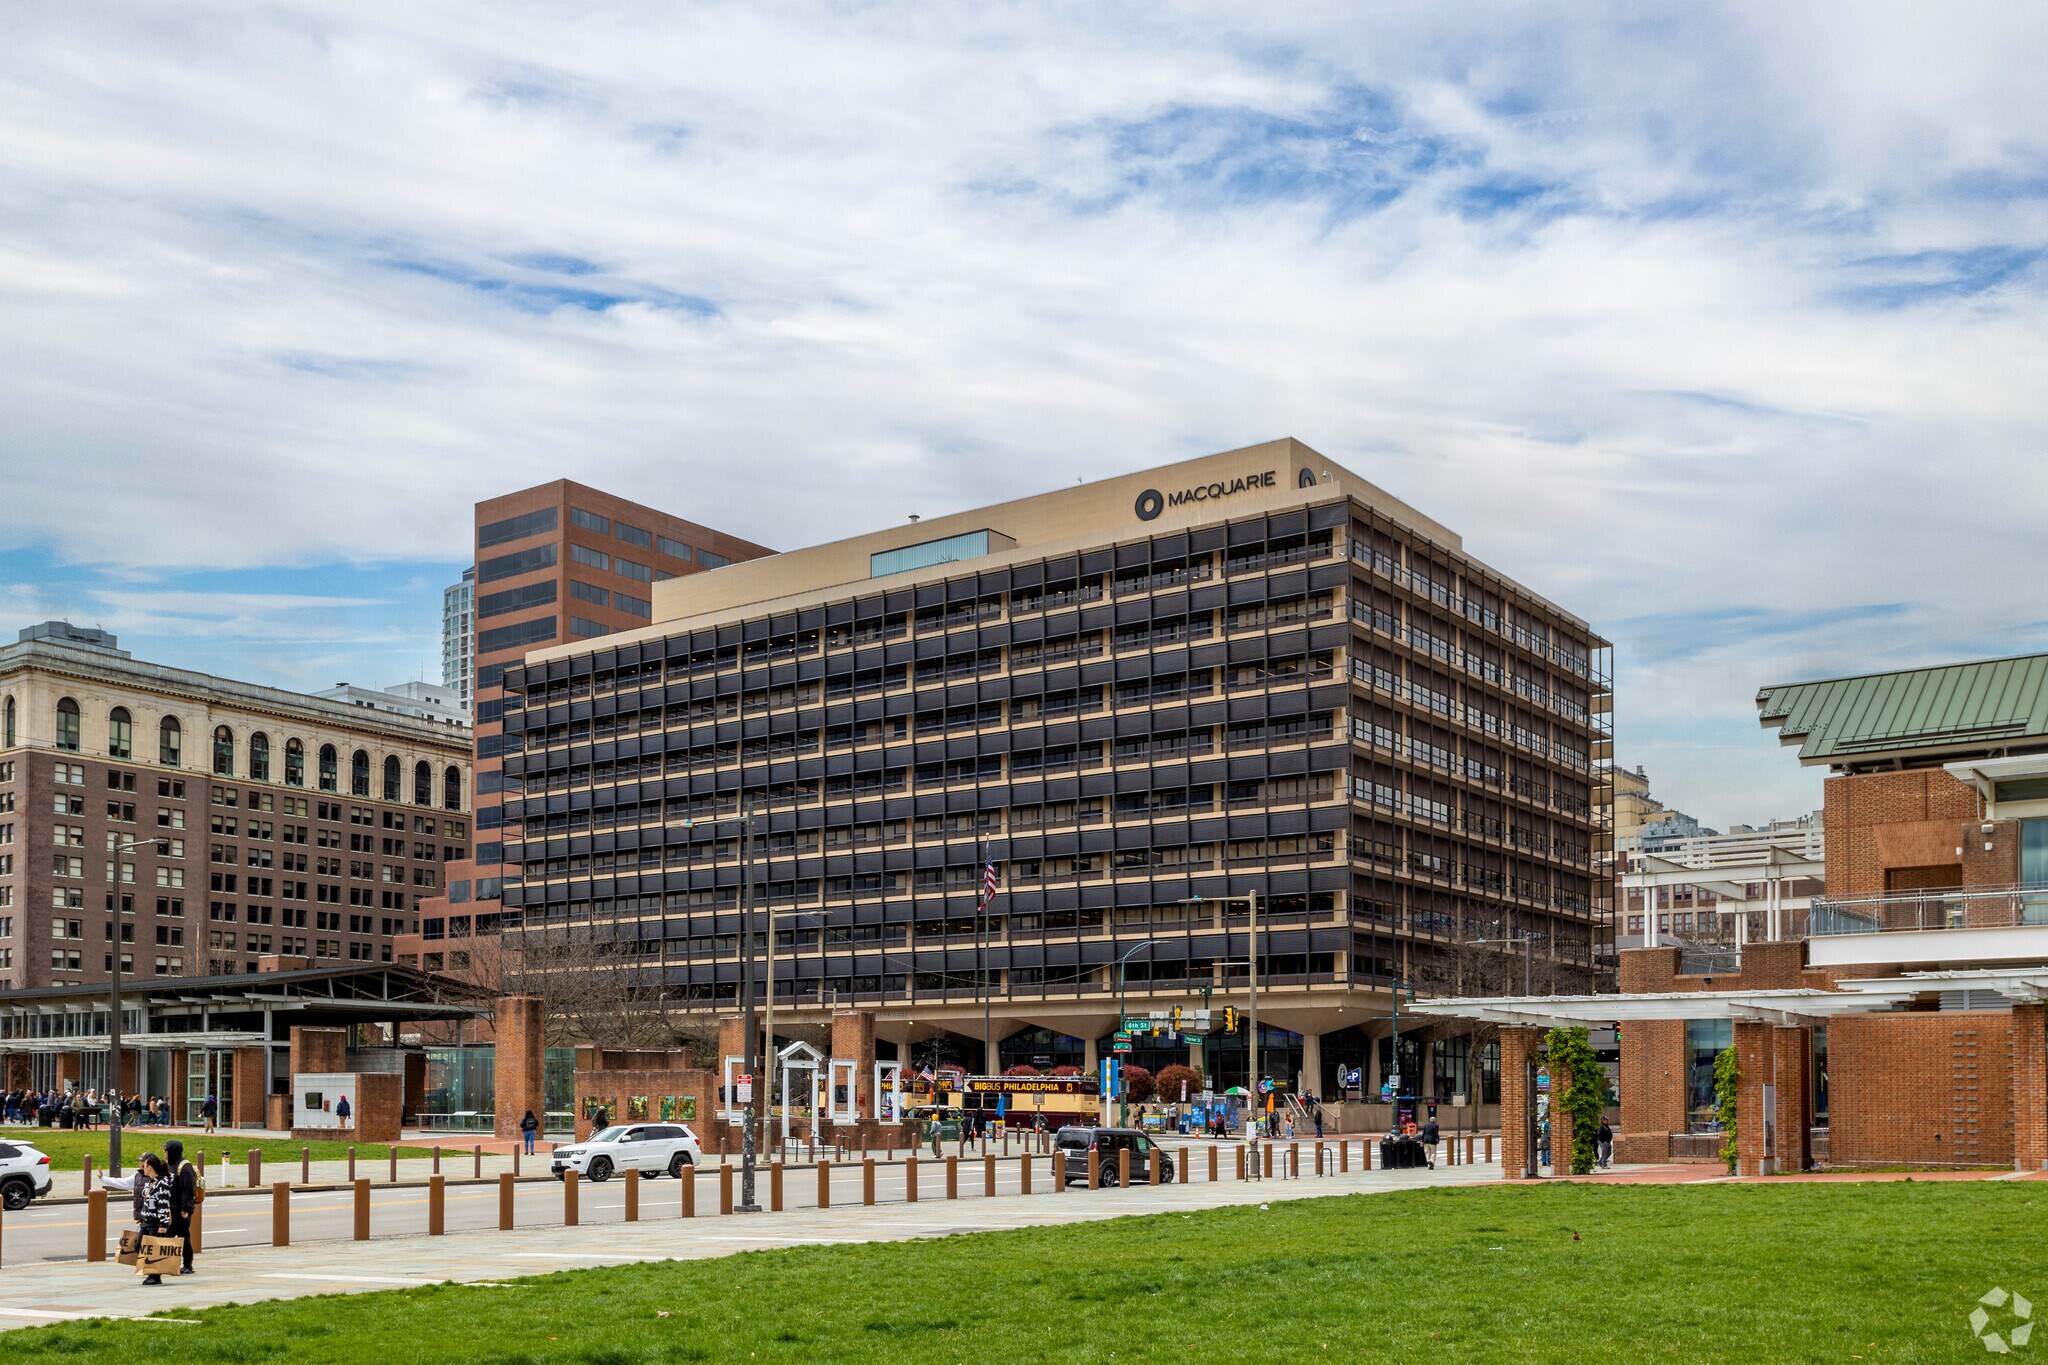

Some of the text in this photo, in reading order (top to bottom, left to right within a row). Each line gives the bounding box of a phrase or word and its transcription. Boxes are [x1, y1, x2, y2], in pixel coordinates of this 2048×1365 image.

[1168, 470, 1276, 507] MACQUARIE
[1351, 1072, 1359, 1080] P
[974, 1082, 1059, 1091] BIGBUS PHILADELPHIA
[160, 1245, 182, 1256] NIKE
